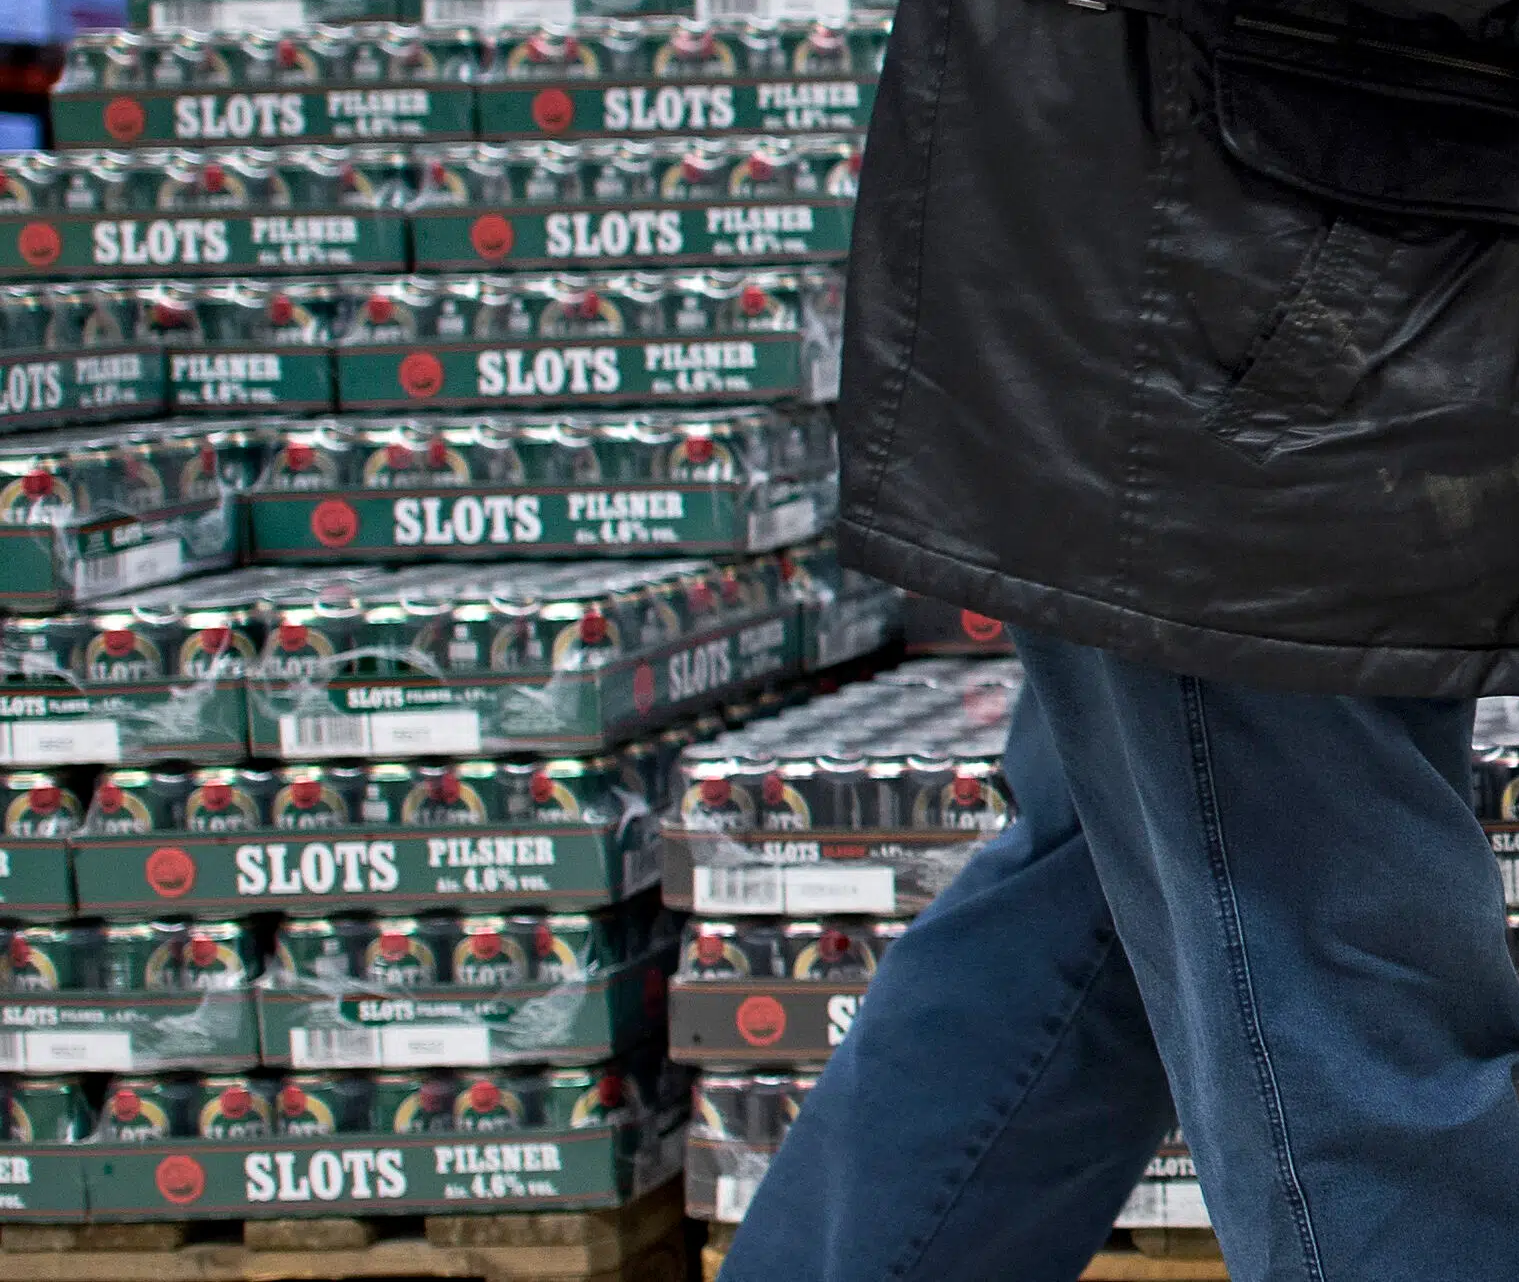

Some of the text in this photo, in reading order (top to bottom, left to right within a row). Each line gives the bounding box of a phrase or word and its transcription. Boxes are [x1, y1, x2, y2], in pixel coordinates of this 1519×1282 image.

[326, 88, 429, 117] PILSNER
[603, 86, 735, 130] SLOTS
[757, 83, 860, 108] PILSNER
[174, 94, 305, 139] SLOTS
[250, 216, 358, 243] PILSNER
[545, 211, 682, 257] SLOTS
[707, 206, 814, 233] PILSNER
[92, 218, 229, 265] SLOTS
[171, 353, 281, 382] PILSNER
[645, 342, 756, 370] PILSNER
[477, 348, 621, 397] SLOTS
[394, 495, 541, 545] SLOTS
[567, 491, 683, 520] PILSNER
[668, 640, 731, 703] SLOTS
[347, 688, 403, 709] SLOTS
[428, 836, 555, 867] PILSNER
[764, 841, 819, 864] SLOTS
[236, 842, 399, 896] SLOTS
[358, 1000, 415, 1020] SLOTS
[435, 1144, 562, 1174] PILSNER
[244, 1148, 406, 1201] SLOTS
